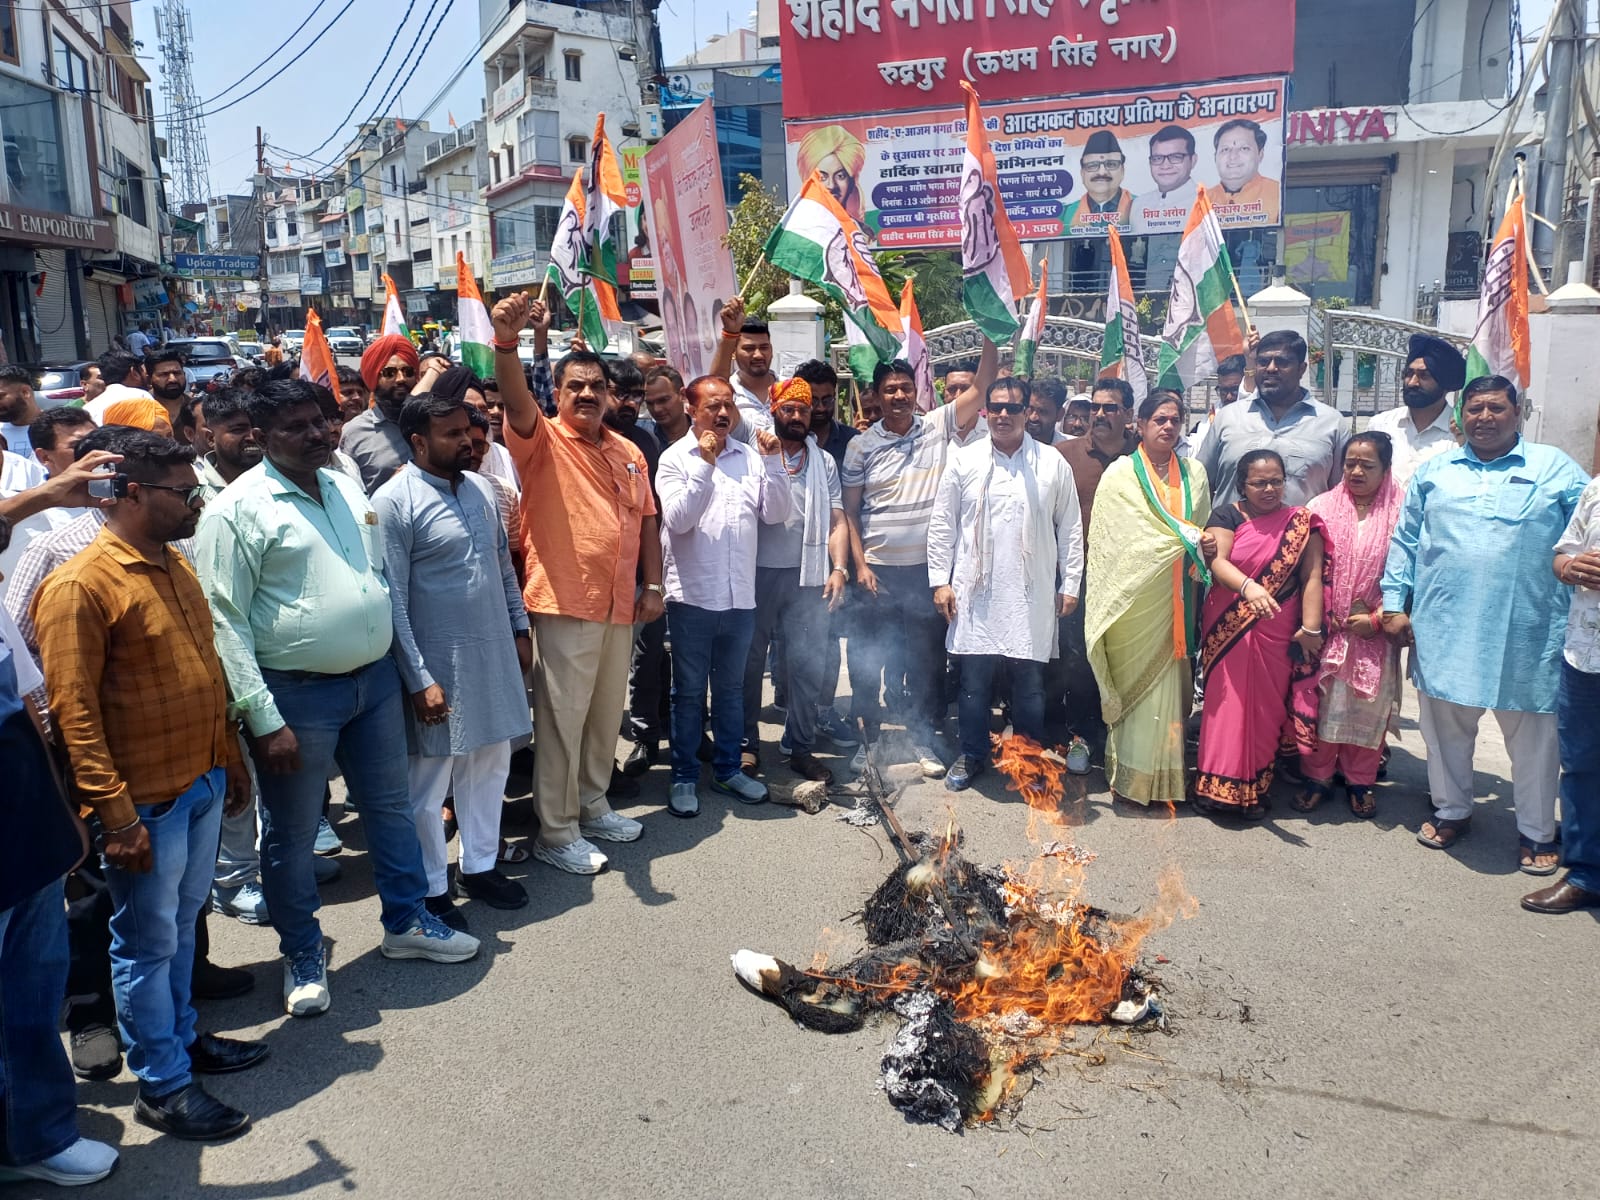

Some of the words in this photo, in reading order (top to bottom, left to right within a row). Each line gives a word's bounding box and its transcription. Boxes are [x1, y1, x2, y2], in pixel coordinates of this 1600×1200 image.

[877, 57, 947, 91] रुद्रपुर
[963, 47, 1038, 82] (ऊधम
[1048, 34, 1098, 67] सिंह
[1108, 26, 1177, 63] नगर)
[1004, 109, 1075, 134] आदमकद
[1123, 98, 1174, 126] प्रतिमा
[1177, 95, 1196, 119] के
[1200, 90, 1276, 117] अनावरण
[880, 164, 920, 178] हार्दिक
[20, 214, 95, 240] EMPORIUM
[186, 257, 217, 268] Upkar
[220, 258, 256, 269] Traders
